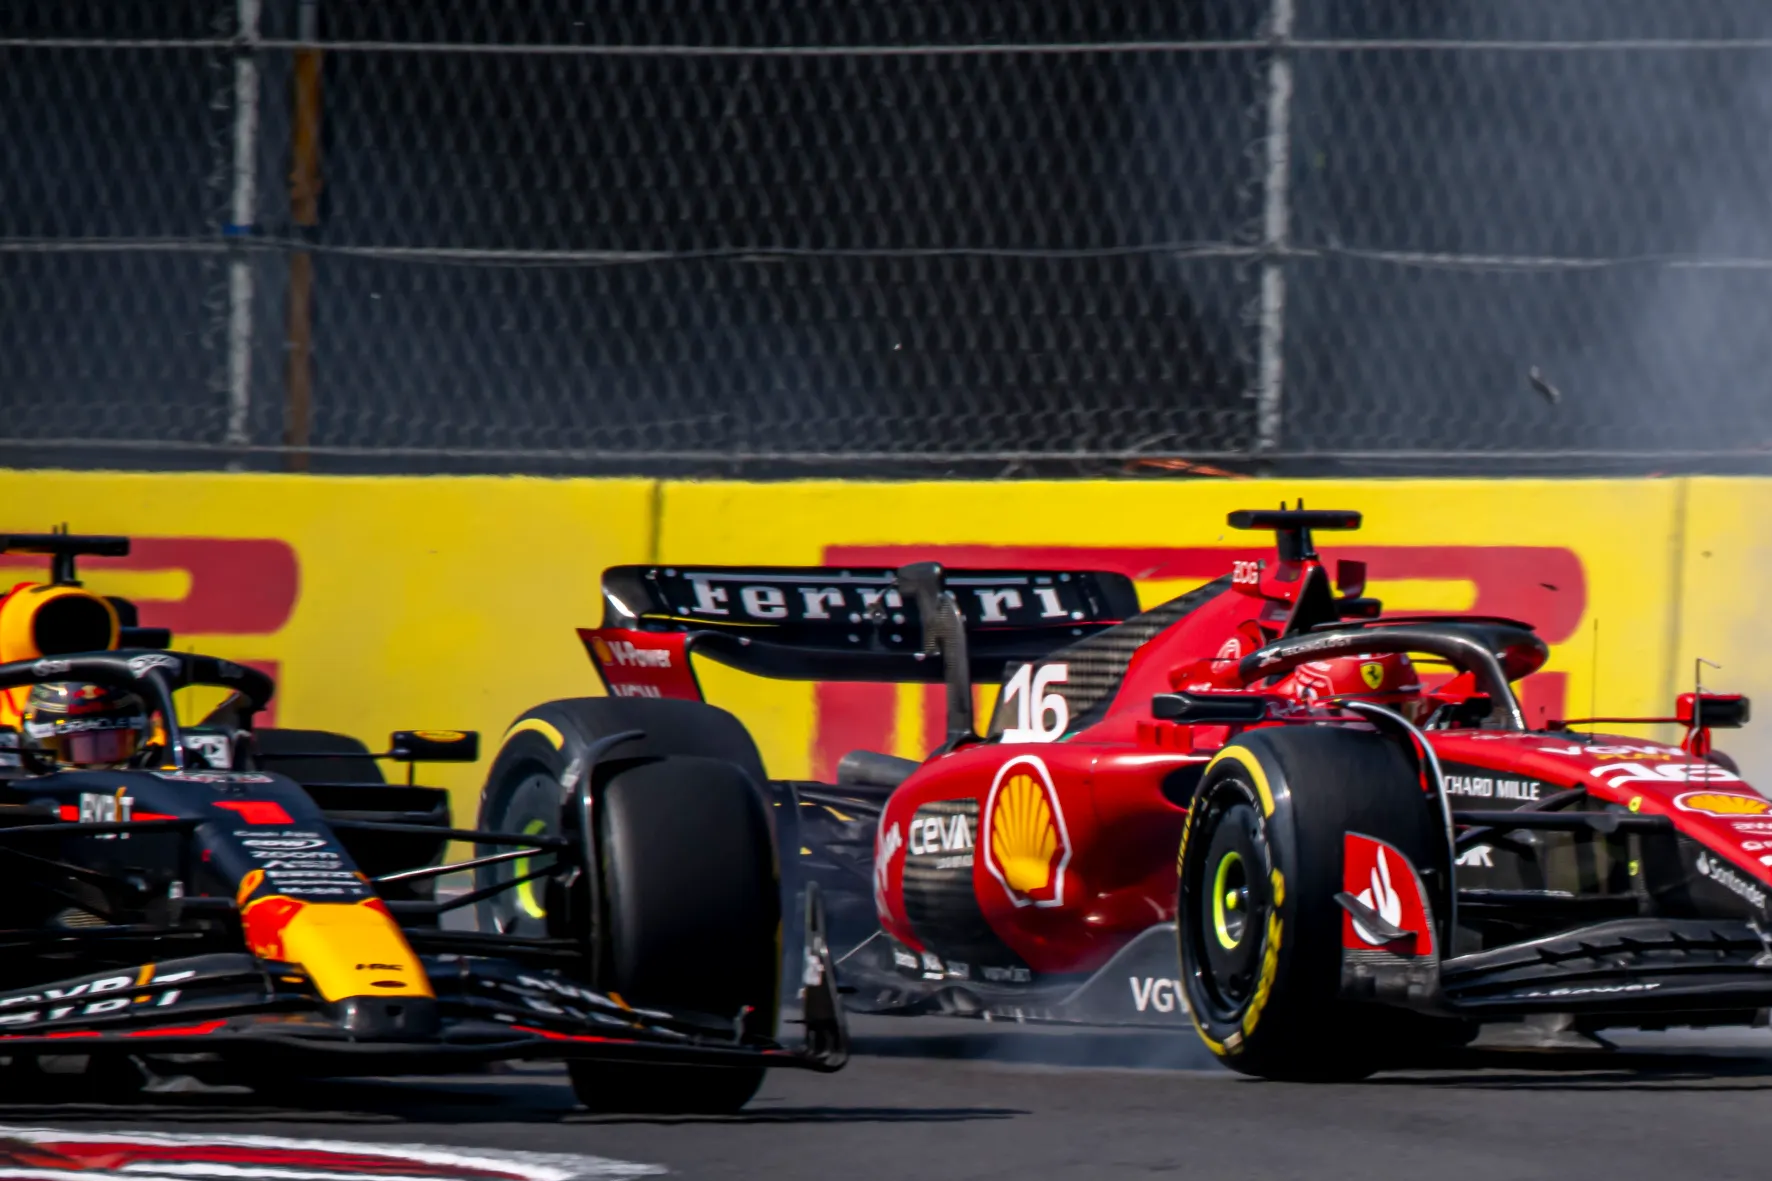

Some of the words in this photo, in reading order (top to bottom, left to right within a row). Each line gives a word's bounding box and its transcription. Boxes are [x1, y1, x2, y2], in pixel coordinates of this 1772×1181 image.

[684, 572, 1067, 621] Ferrri
[1003, 663, 1069, 743] 16
[1444, 775, 1493, 797] CHARD
[1496, 780, 1541, 801] MILLE
